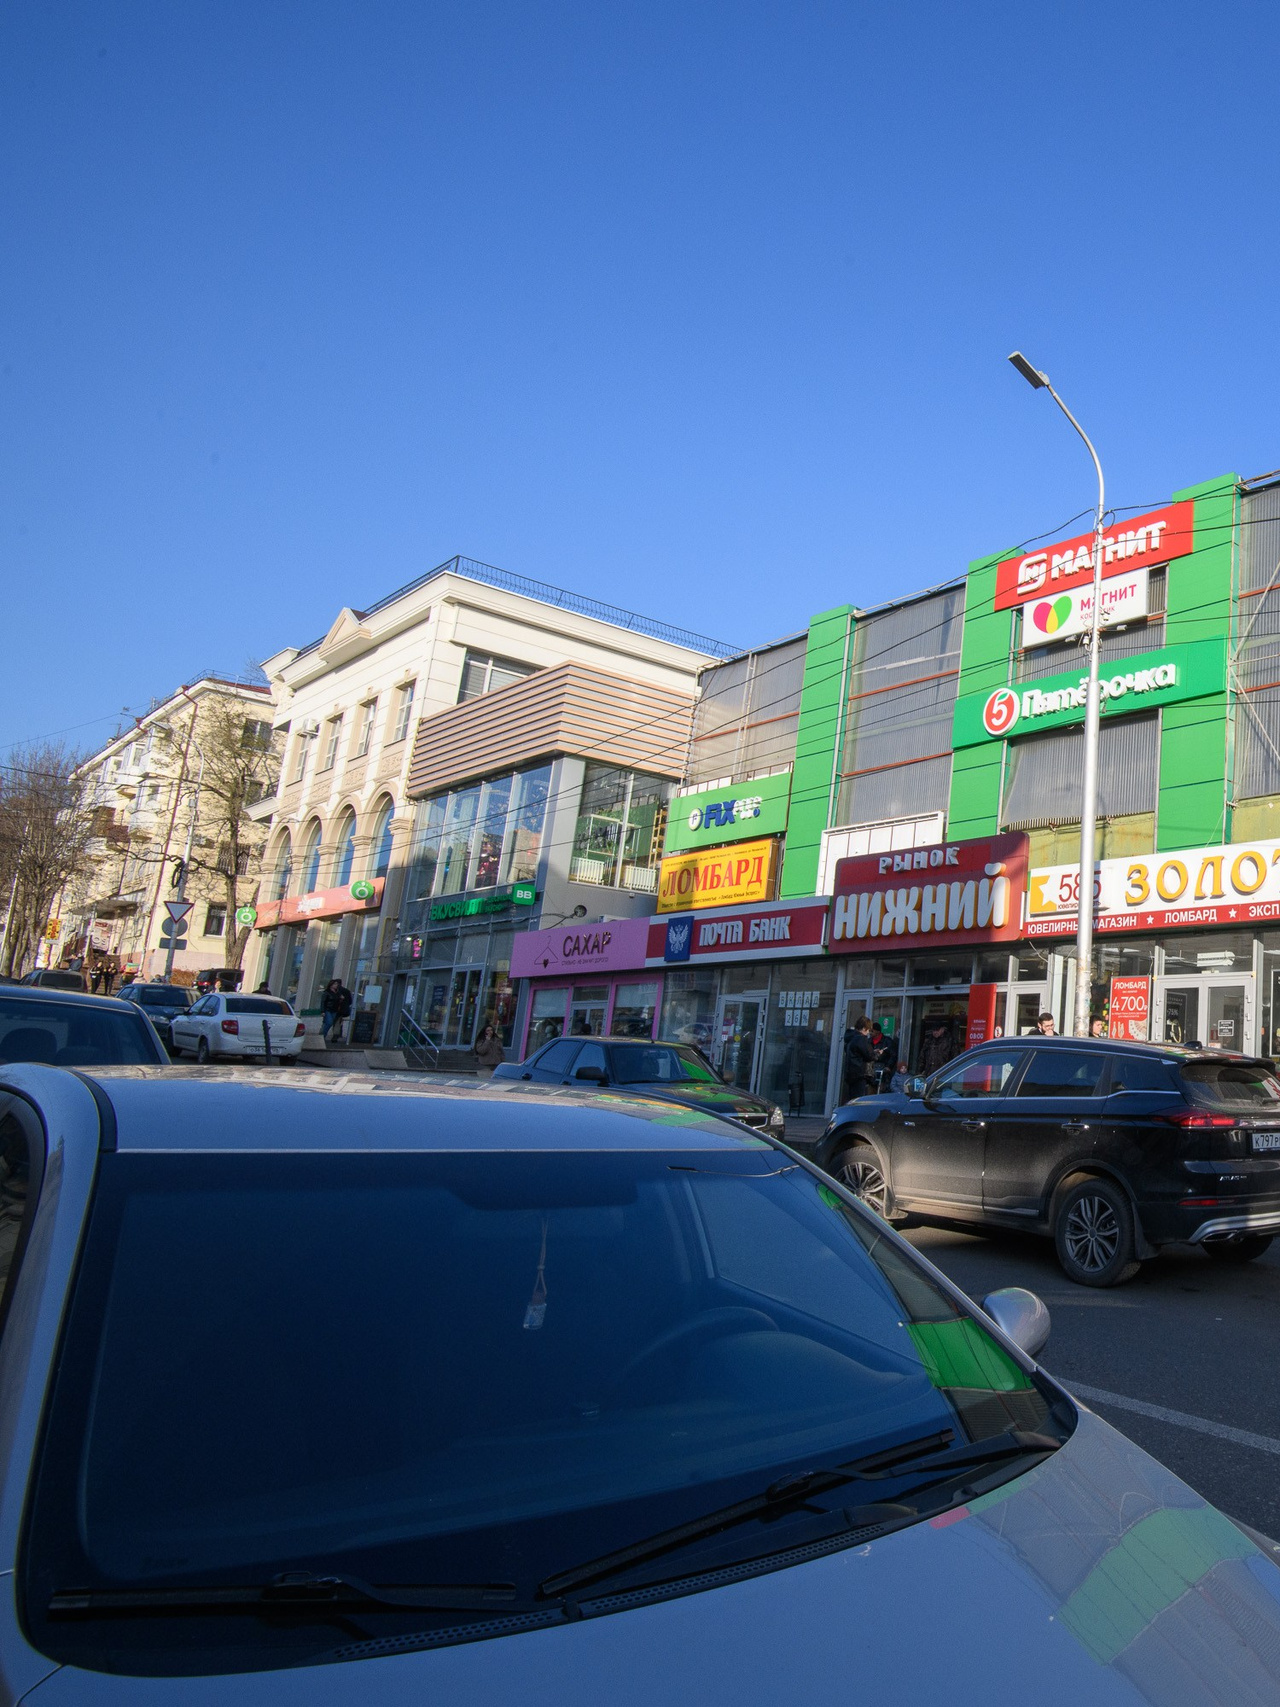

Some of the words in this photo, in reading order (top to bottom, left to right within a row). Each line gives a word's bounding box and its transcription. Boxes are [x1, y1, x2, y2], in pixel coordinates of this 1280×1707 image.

[1051, 521, 1166, 580] МАГНИТ
[1080, 583, 1137, 611] МГНИТ
[1021, 663, 1176, 718] Пятёрочка
[879, 847, 960, 875] РЫНОК
[662, 855, 764, 898] ЛОМБАРД
[834, 863, 1010, 941] НИЖНИЙ
[1164, 908, 1218, 924] ЛОМБАРД
[699, 920, 743, 947] ПОЧТА
[749, 916, 792, 943] БАНК
[1027, 921, 1079, 935] ЮВЕЛИРНЫ
[562, 931, 611, 957] САХАР
[1114, 981, 1147, 990] ЛОМБАРД
